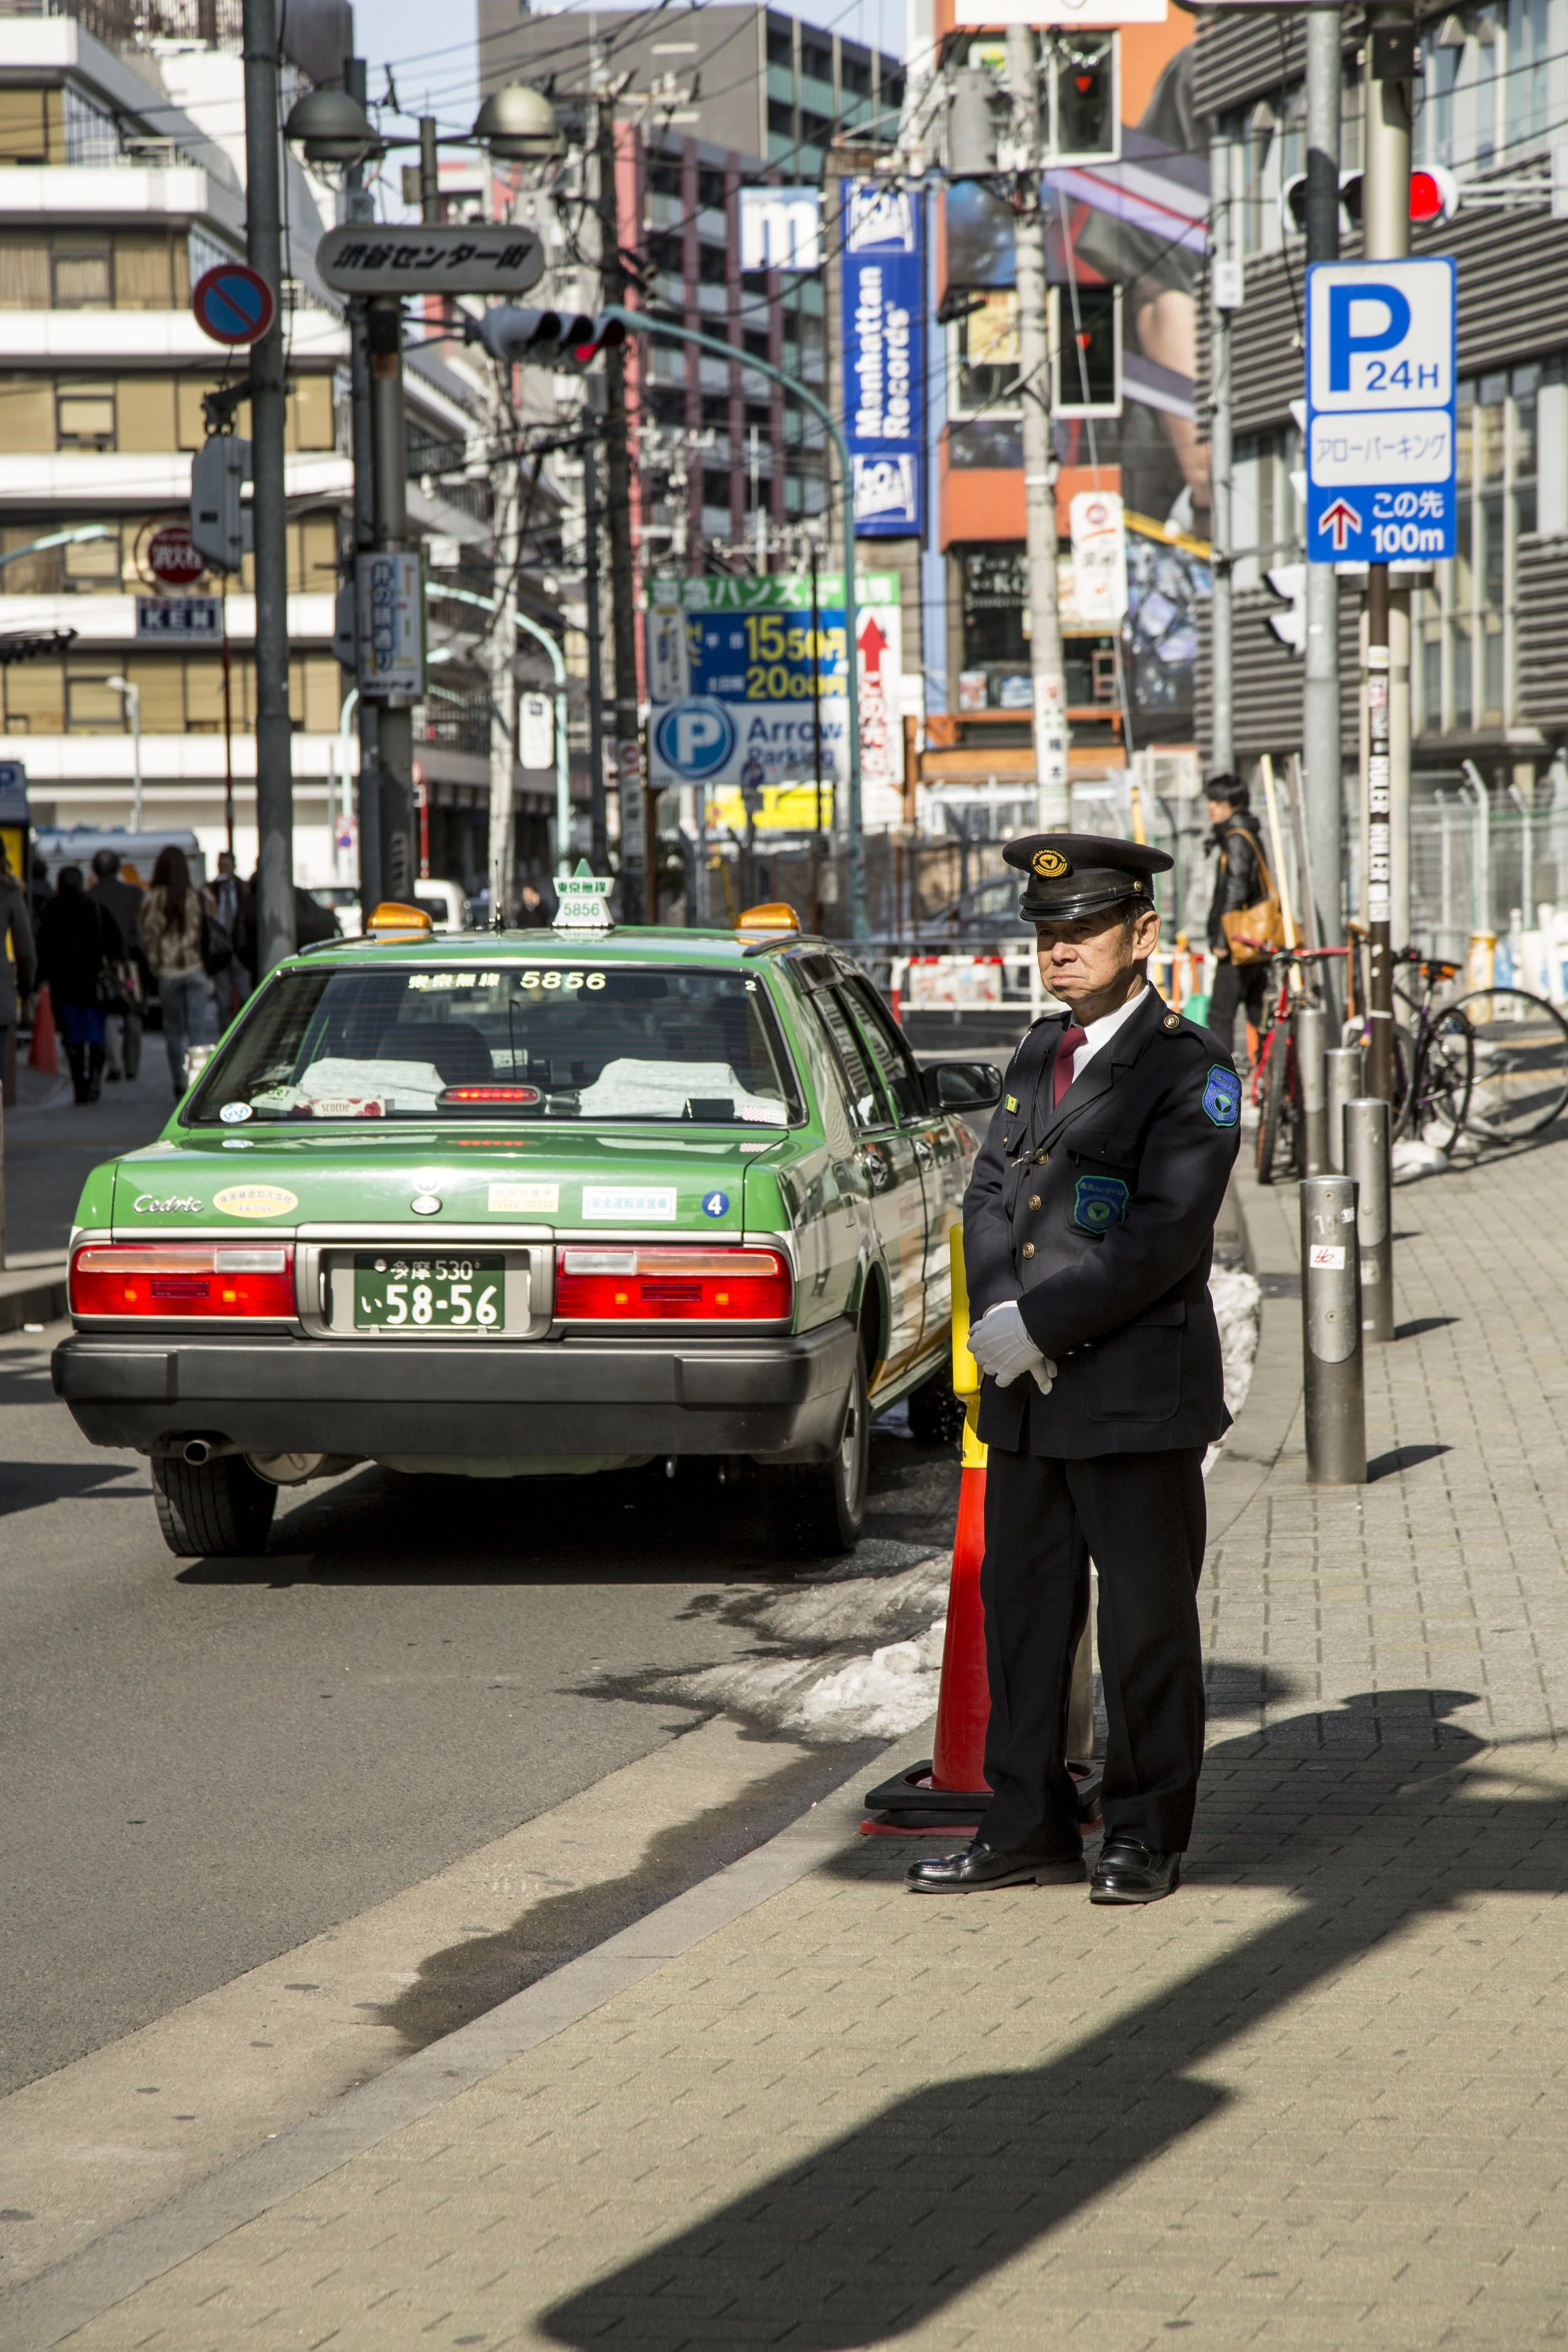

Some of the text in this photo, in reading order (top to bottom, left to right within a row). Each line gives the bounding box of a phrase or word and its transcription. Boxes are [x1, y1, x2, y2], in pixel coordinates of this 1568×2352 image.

[332, 242, 533, 270] 渋谷センター街
[1329, 283, 1411, 393] P
[855, 267, 882, 438] Manhattan
[883, 307, 910, 438] Records
[1365, 359, 1439, 391] 24H
[1372, 490, 1444, 519] この先
[1371, 523, 1444, 553] 100m
[747, 716, 842, 743] Arrow
[558, 881, 606, 893] 東京無線
[564, 903, 600, 916] 5856
[408, 972, 607, 990] 東京無線 5856
[745, 980, 757, 991] 2
[321, 1103, 351, 1113] scottie
[133, 1194, 203, 1213] Cedric
[707, 1194, 723, 1215] 4
[390, 1260, 474, 1281] 多摩 530
[361, 1285, 497, 1325] い 58-56
